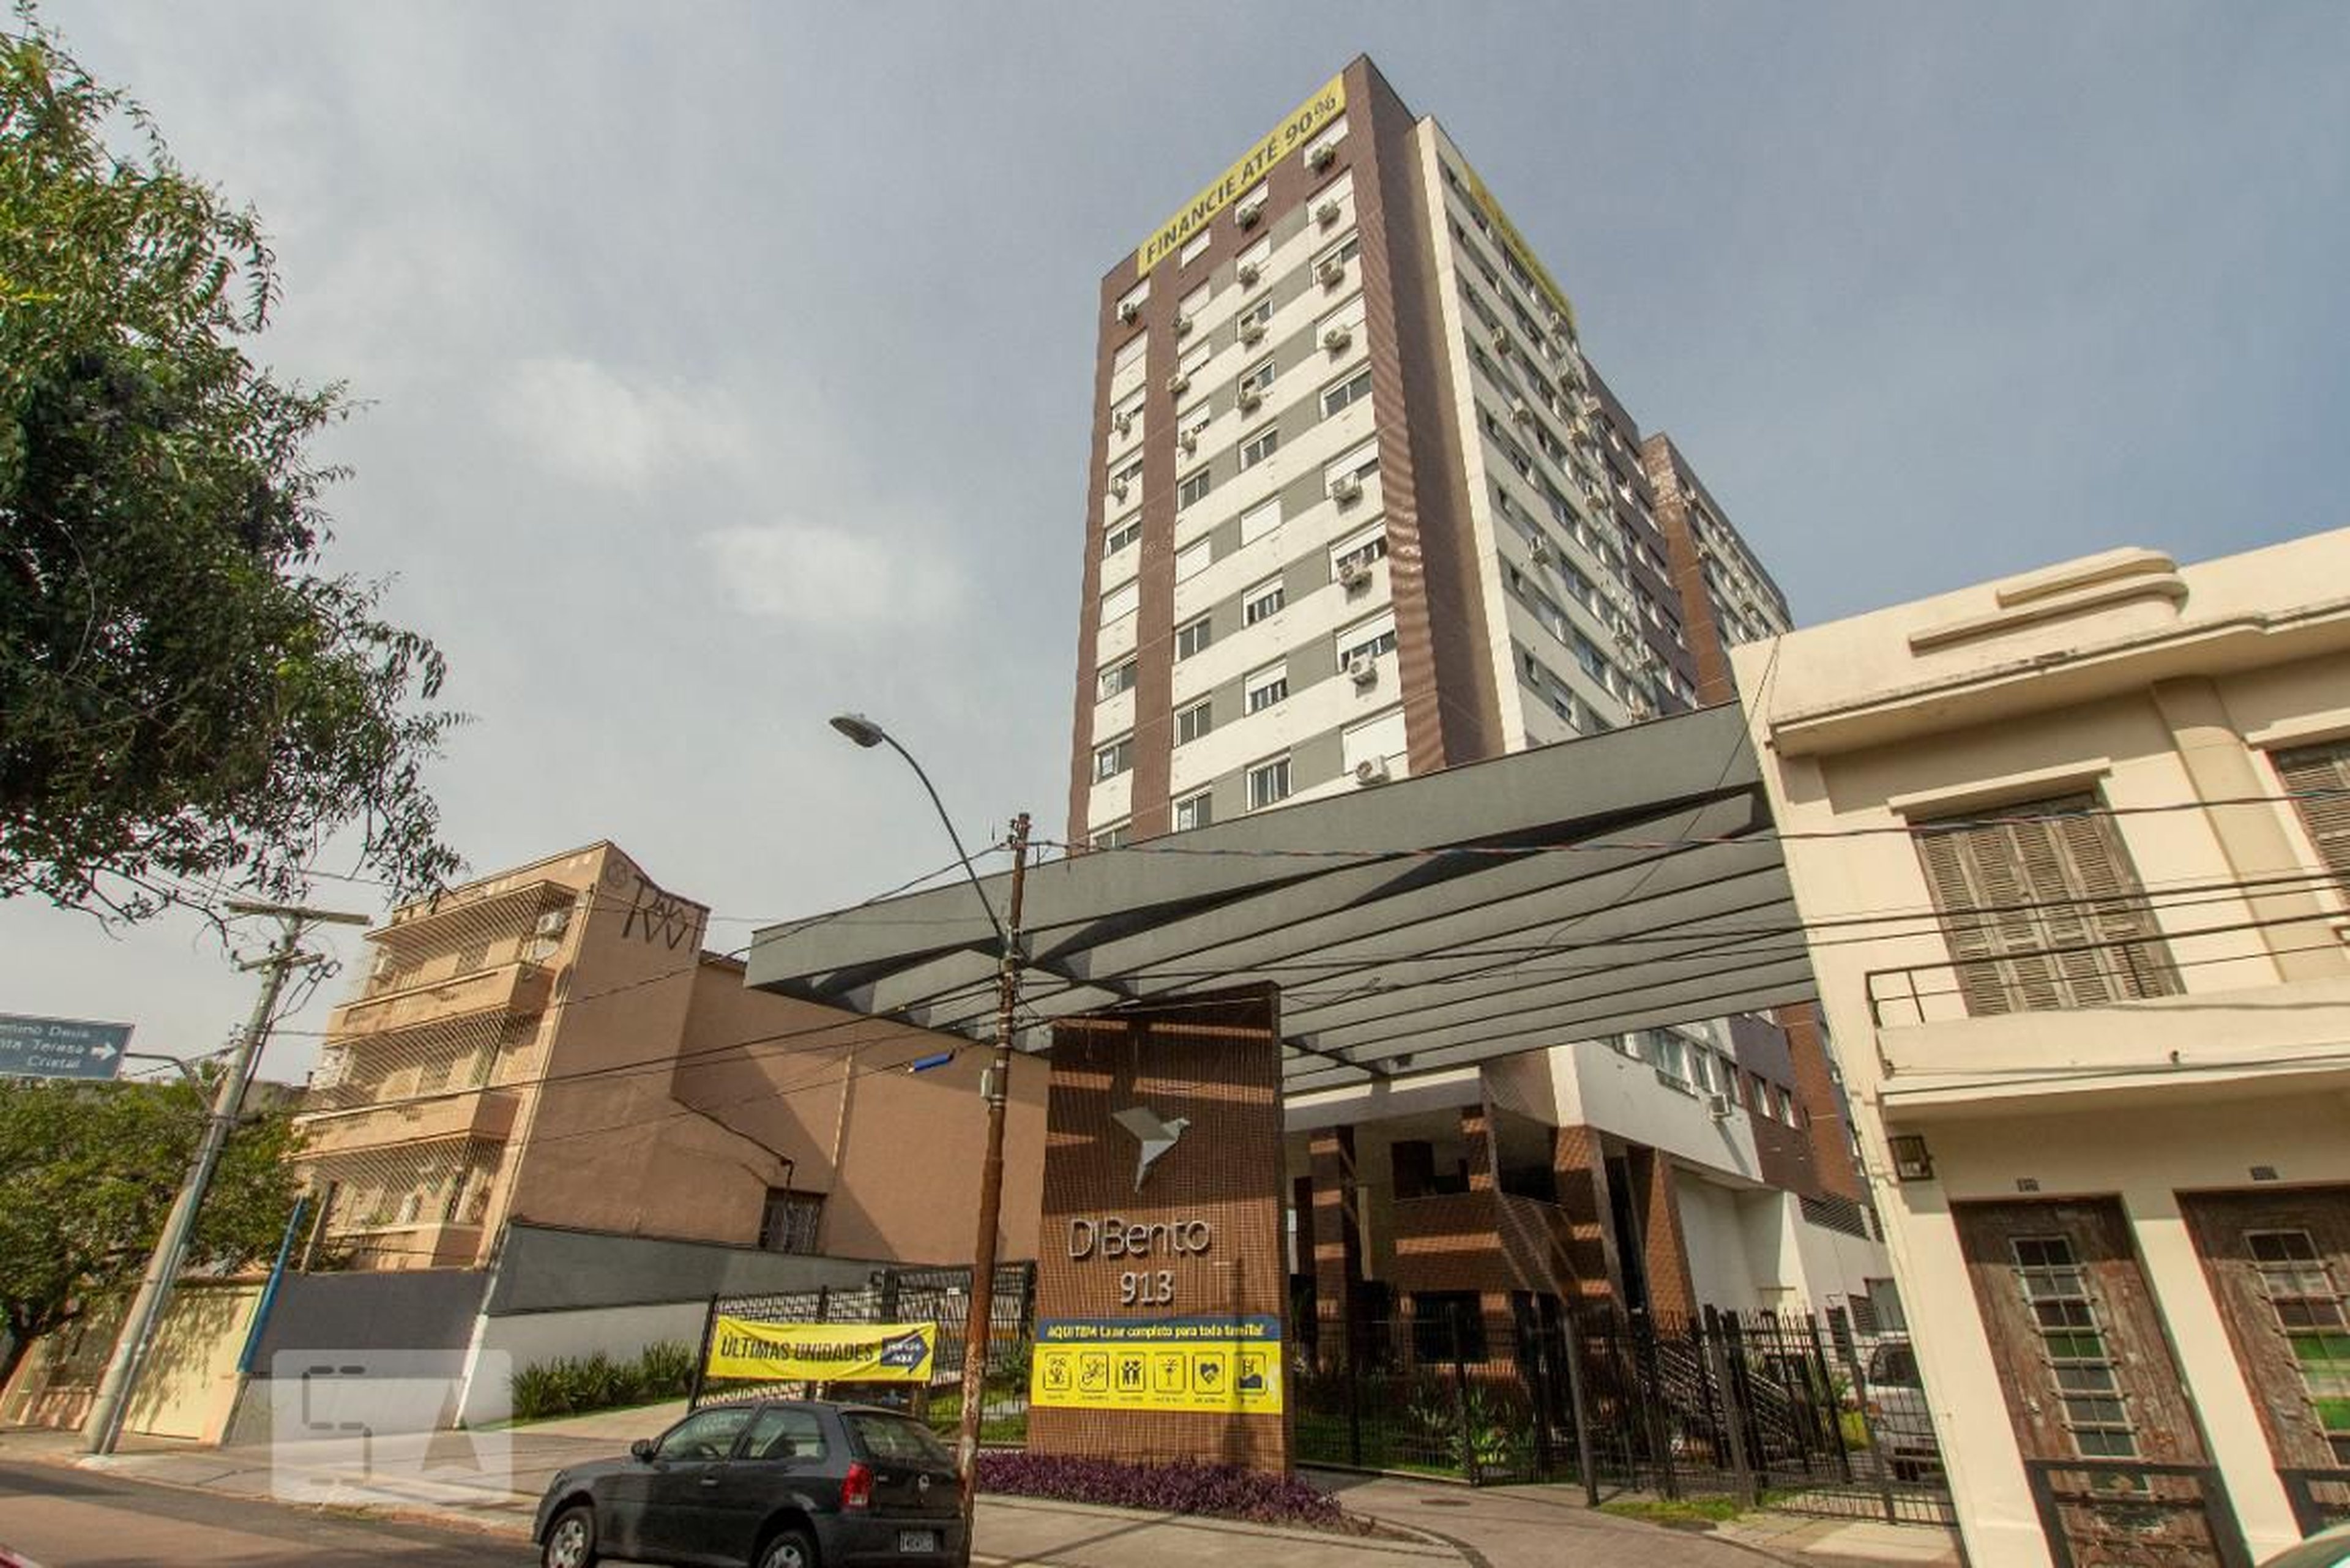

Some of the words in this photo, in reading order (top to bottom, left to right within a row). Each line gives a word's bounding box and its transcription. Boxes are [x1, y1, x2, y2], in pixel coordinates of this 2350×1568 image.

[1146, 175, 1236, 264] FINANCIE
[1242, 137, 1278, 184] ATÉ
[1285, 93, 1337, 146] 90%
[1121, 1270, 1174, 1304] 913
[721, 1332, 791, 1361] ÚLTIMAS
[794, 1342, 873, 1362] UNIDADES
[1127, 1324, 1173, 1340] completo
[1175, 1326, 1198, 1339] para
[1199, 1324, 1223, 1337] toda
